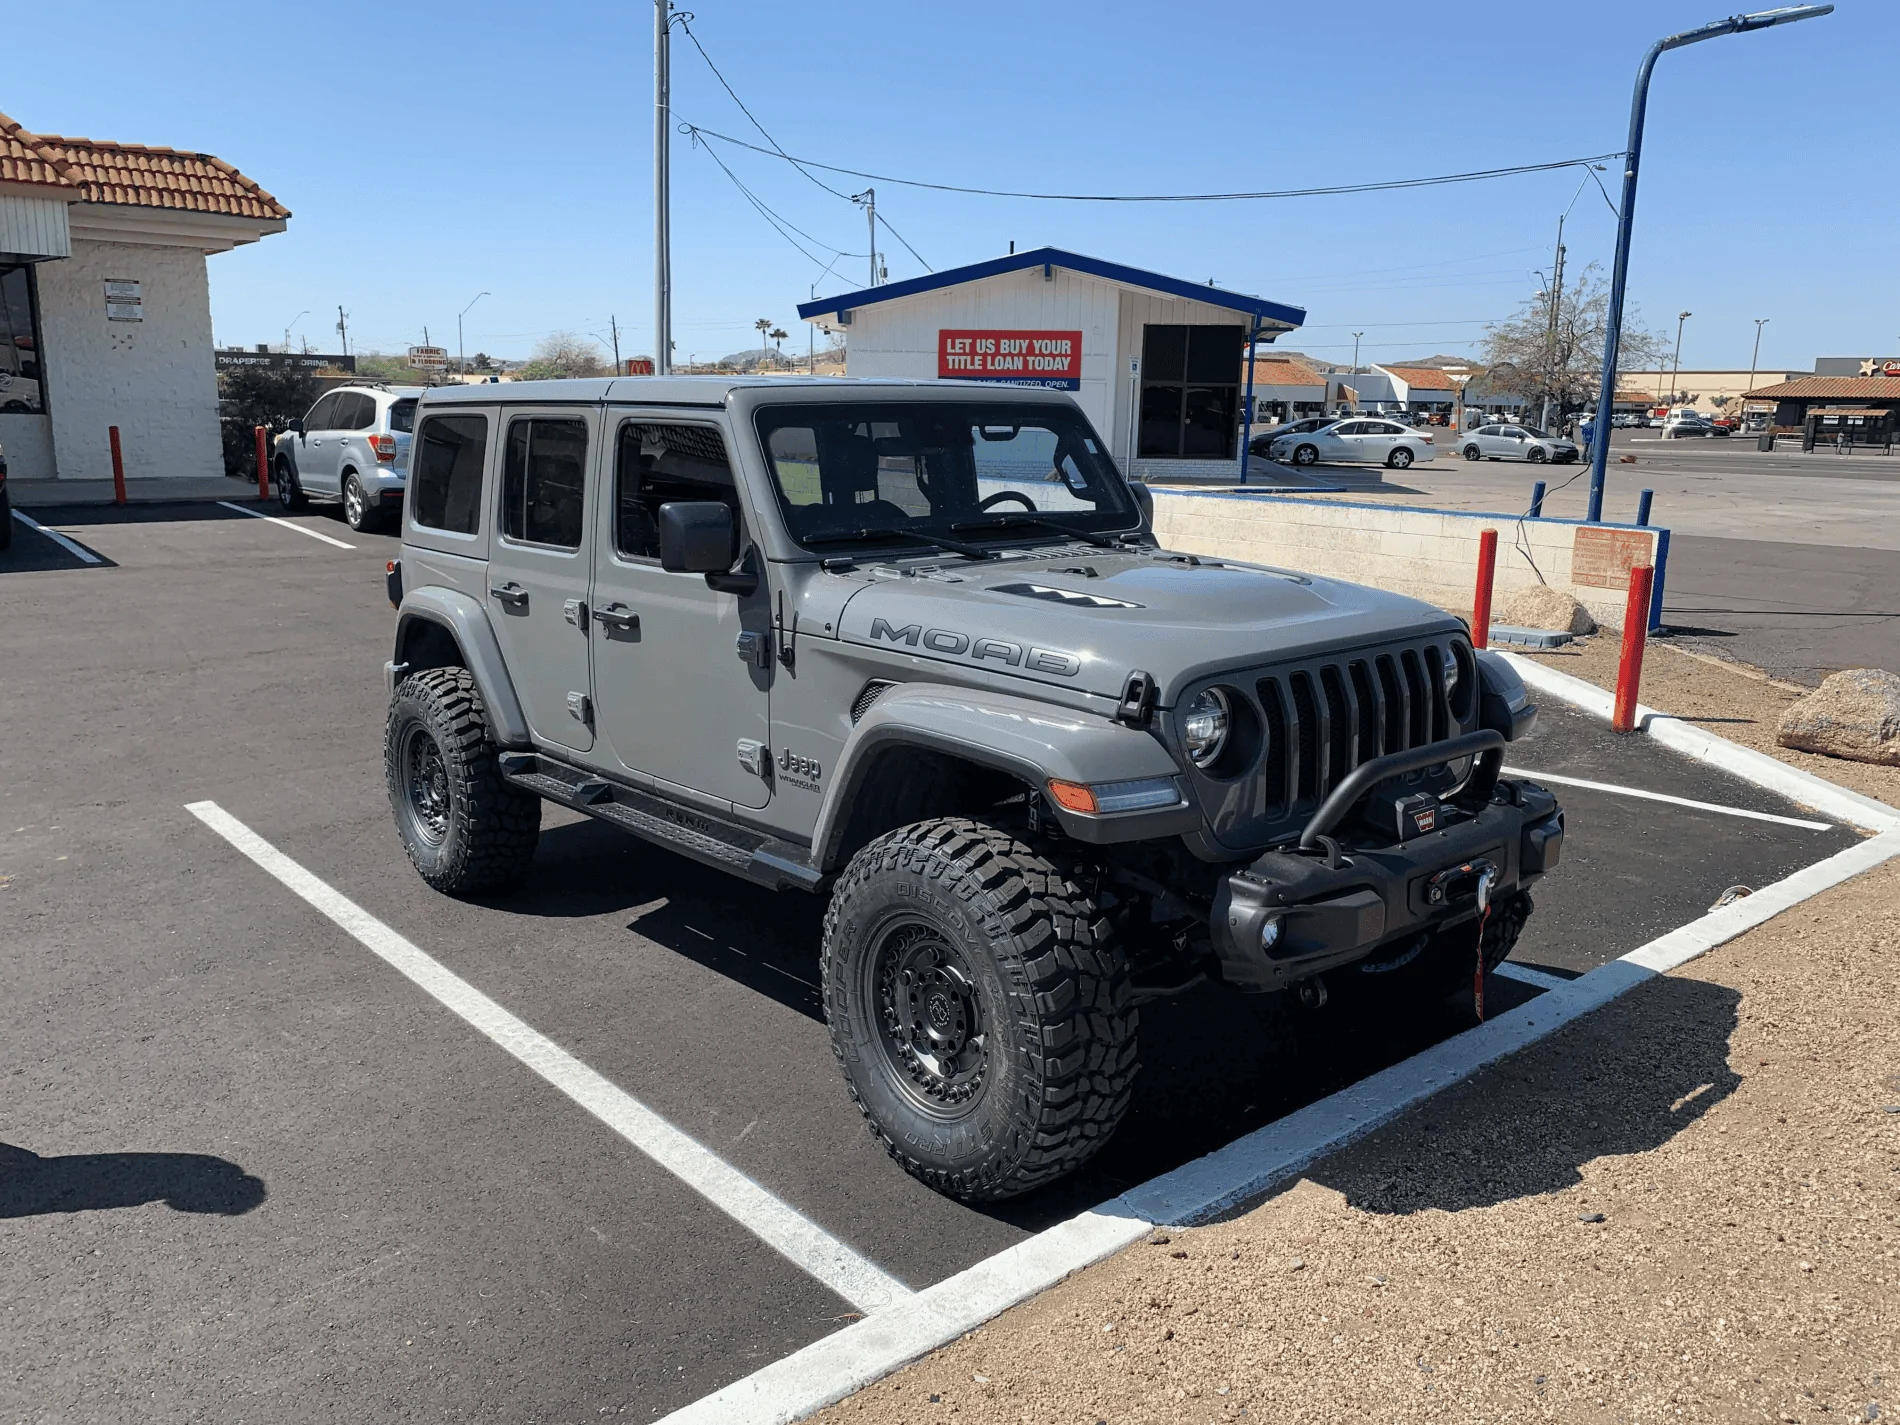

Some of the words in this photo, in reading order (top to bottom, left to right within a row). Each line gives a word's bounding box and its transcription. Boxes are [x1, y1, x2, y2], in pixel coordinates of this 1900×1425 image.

[946, 339, 972, 353] LET
[976, 339, 996, 354] US
[1000, 339, 1029, 354] BUY
[1033, 340, 1072, 355] YOUR
[284, 359, 329, 367] FLORING
[946, 356, 983, 370] TITLE
[986, 356, 1023, 370] LOAN
[1026, 357, 1072, 371] TODAY
[869, 617, 1082, 678] MOAB
[777, 747, 822, 782] Jeep
[778, 774, 821, 791] WRANGLER
[835, 917, 861, 1063] COOPER
